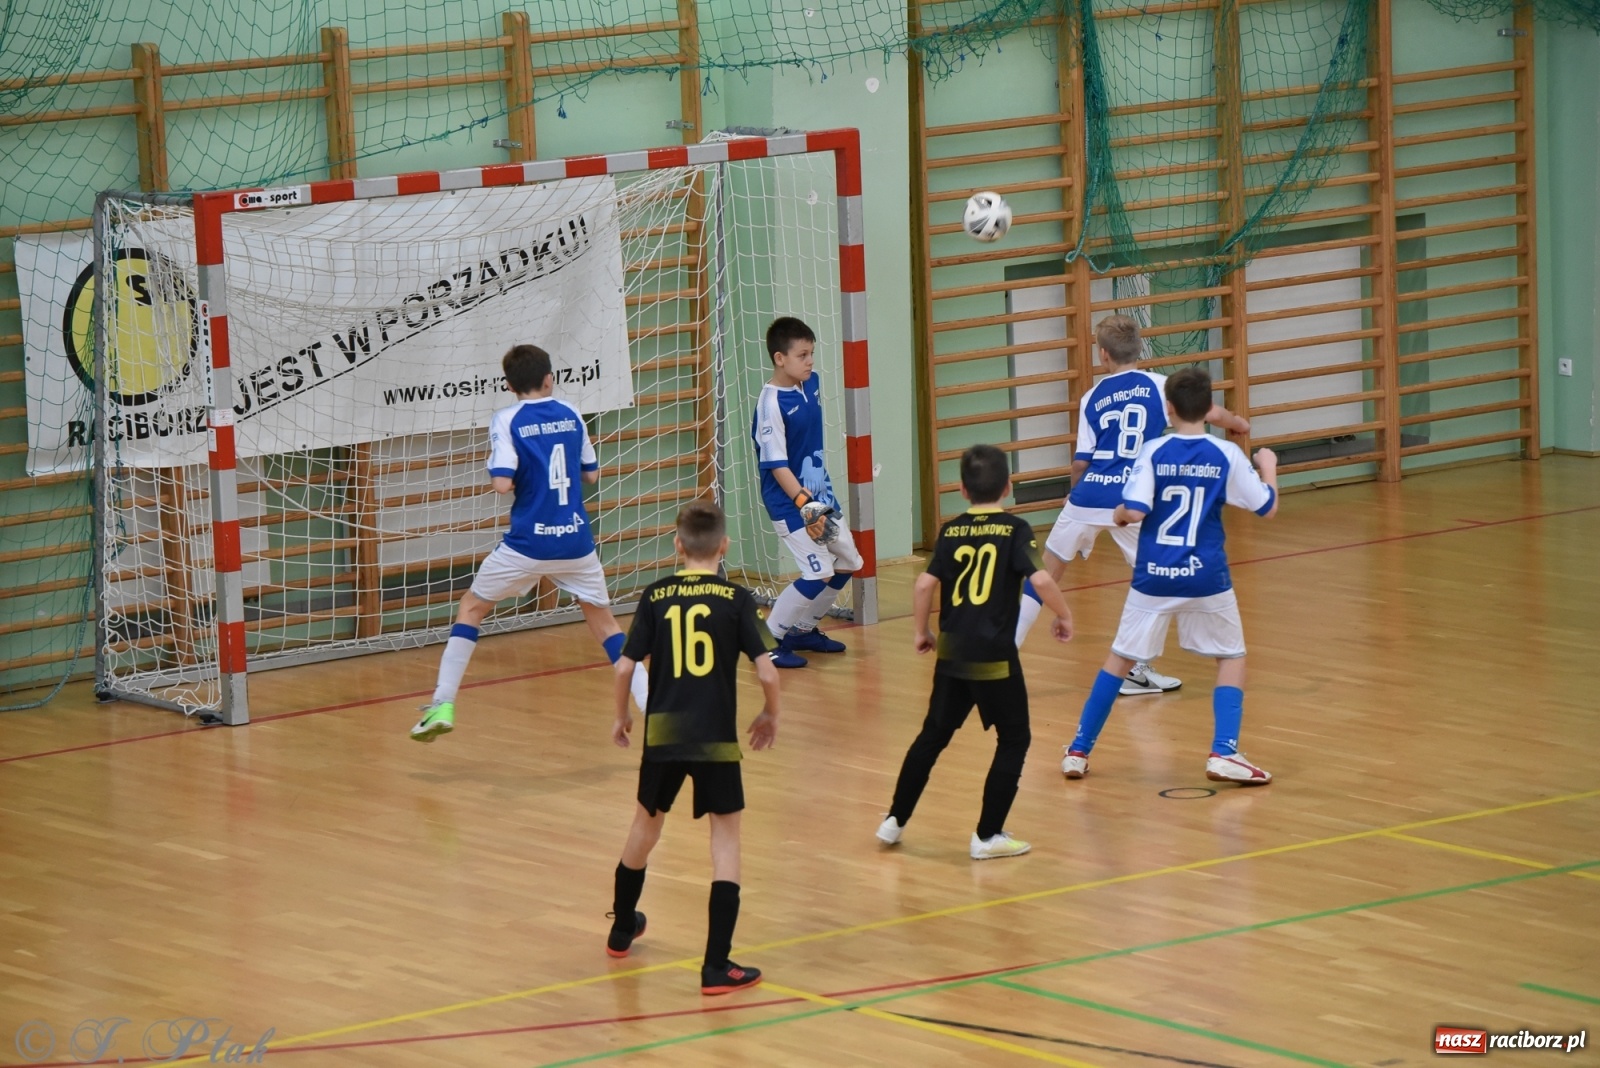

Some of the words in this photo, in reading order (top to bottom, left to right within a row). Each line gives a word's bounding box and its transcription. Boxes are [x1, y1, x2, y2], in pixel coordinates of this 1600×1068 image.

[270, 190, 297, 205] sport
[232, 340, 323, 416] JEST
[332, 320, 371, 364] W
[383, 359, 601, 406] www.osir-rarz.pl
[1094, 395, 1112, 412] UNIA
[518, 423, 541, 438] UNIA
[541, 417, 577, 434] RACIBÓRZ
[1092, 403, 1147, 460] 28
[548, 443, 571, 506] 4
[1178, 462, 1222, 479] RACIBÓRZ
[959, 525, 970, 538] 07
[1155, 484, 1205, 547] 21
[806, 552, 821, 573] 6
[951, 542, 997, 607] 20
[666, 584, 677, 598] 07
[677, 583, 736, 601] MARKOWICE
[663, 603, 714, 679] 16
